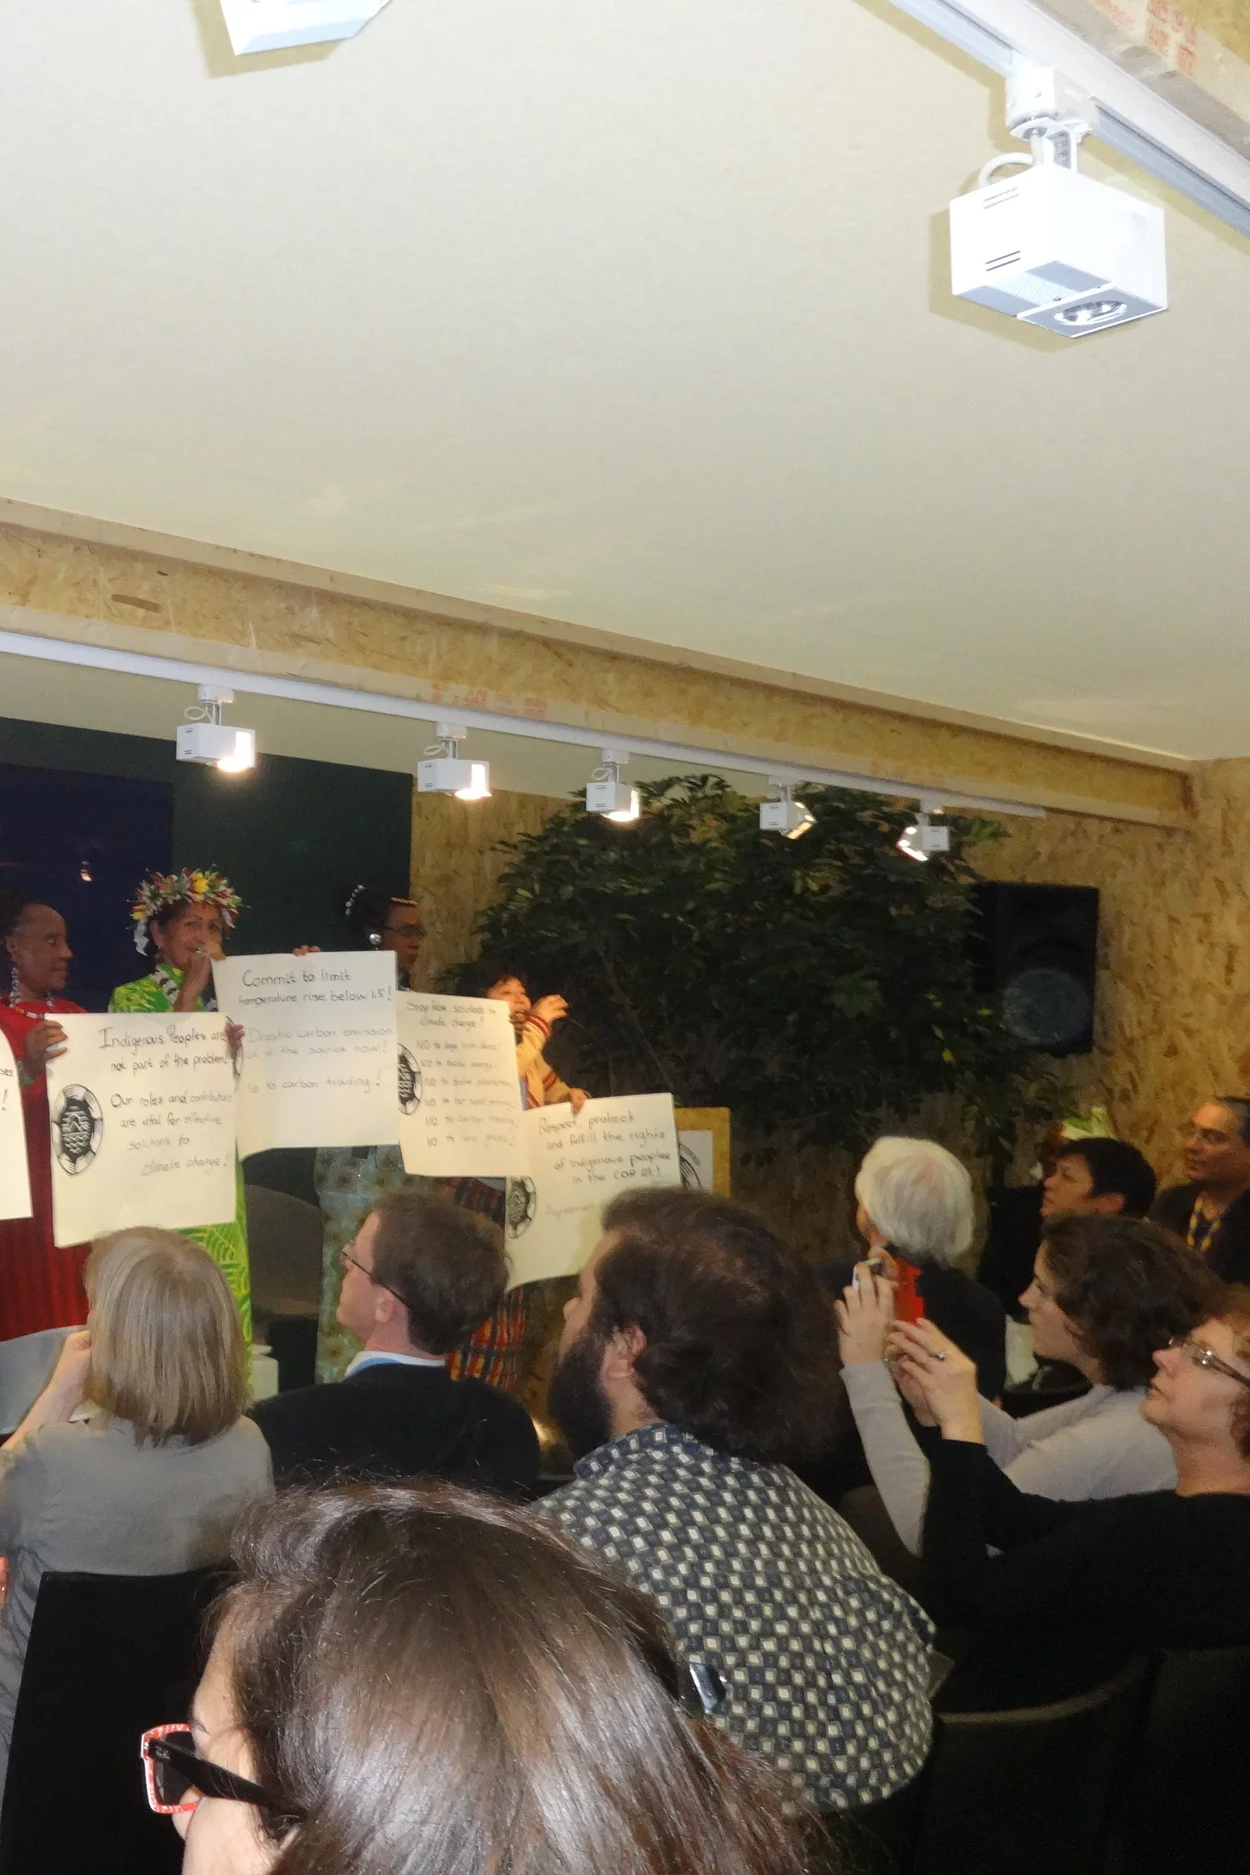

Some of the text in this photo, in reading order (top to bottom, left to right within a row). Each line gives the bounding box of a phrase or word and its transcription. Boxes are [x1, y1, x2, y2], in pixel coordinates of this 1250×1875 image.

[242, 968, 352, 988] Commit to limit
[238, 993, 297, 1008] temperature
[302, 991, 326, 1002] rise
[330, 990, 367, 1002] below
[406, 1001, 430, 1014] Stop
[98, 1026, 164, 1056] Indigenous
[166, 1025, 207, 1048] Peoples
[249, 1026, 393, 1043] Drastic carbon emission
[281, 1045, 300, 1055] the
[307, 1044, 347, 1055] source
[110, 1058, 126, 1073] not
[132, 1056, 155, 1076] part
[159, 1054, 170, 1069] of
[174, 1053, 189, 1067] the
[266, 1080, 276, 1091] to
[282, 1075, 318, 1088] carbon
[110, 1093, 134, 1108] Our
[139, 1090, 163, 1107] roles
[168, 1088, 187, 1104] and
[120, 1117, 137, 1130] are
[142, 1112, 162, 1127] vital
[166, 1111, 181, 1127] for
[588, 1109, 634, 1130] protect
[178, 1135, 190, 1147] to
[546, 1127, 665, 1150] and fulfill the rights
[140, 1157, 181, 1177] climate
[554, 1157, 566, 1171] of
[570, 1155, 623, 1174] indigenous
[629, 1150, 671, 1168] peoples
[588, 1173, 609, 1186] the
